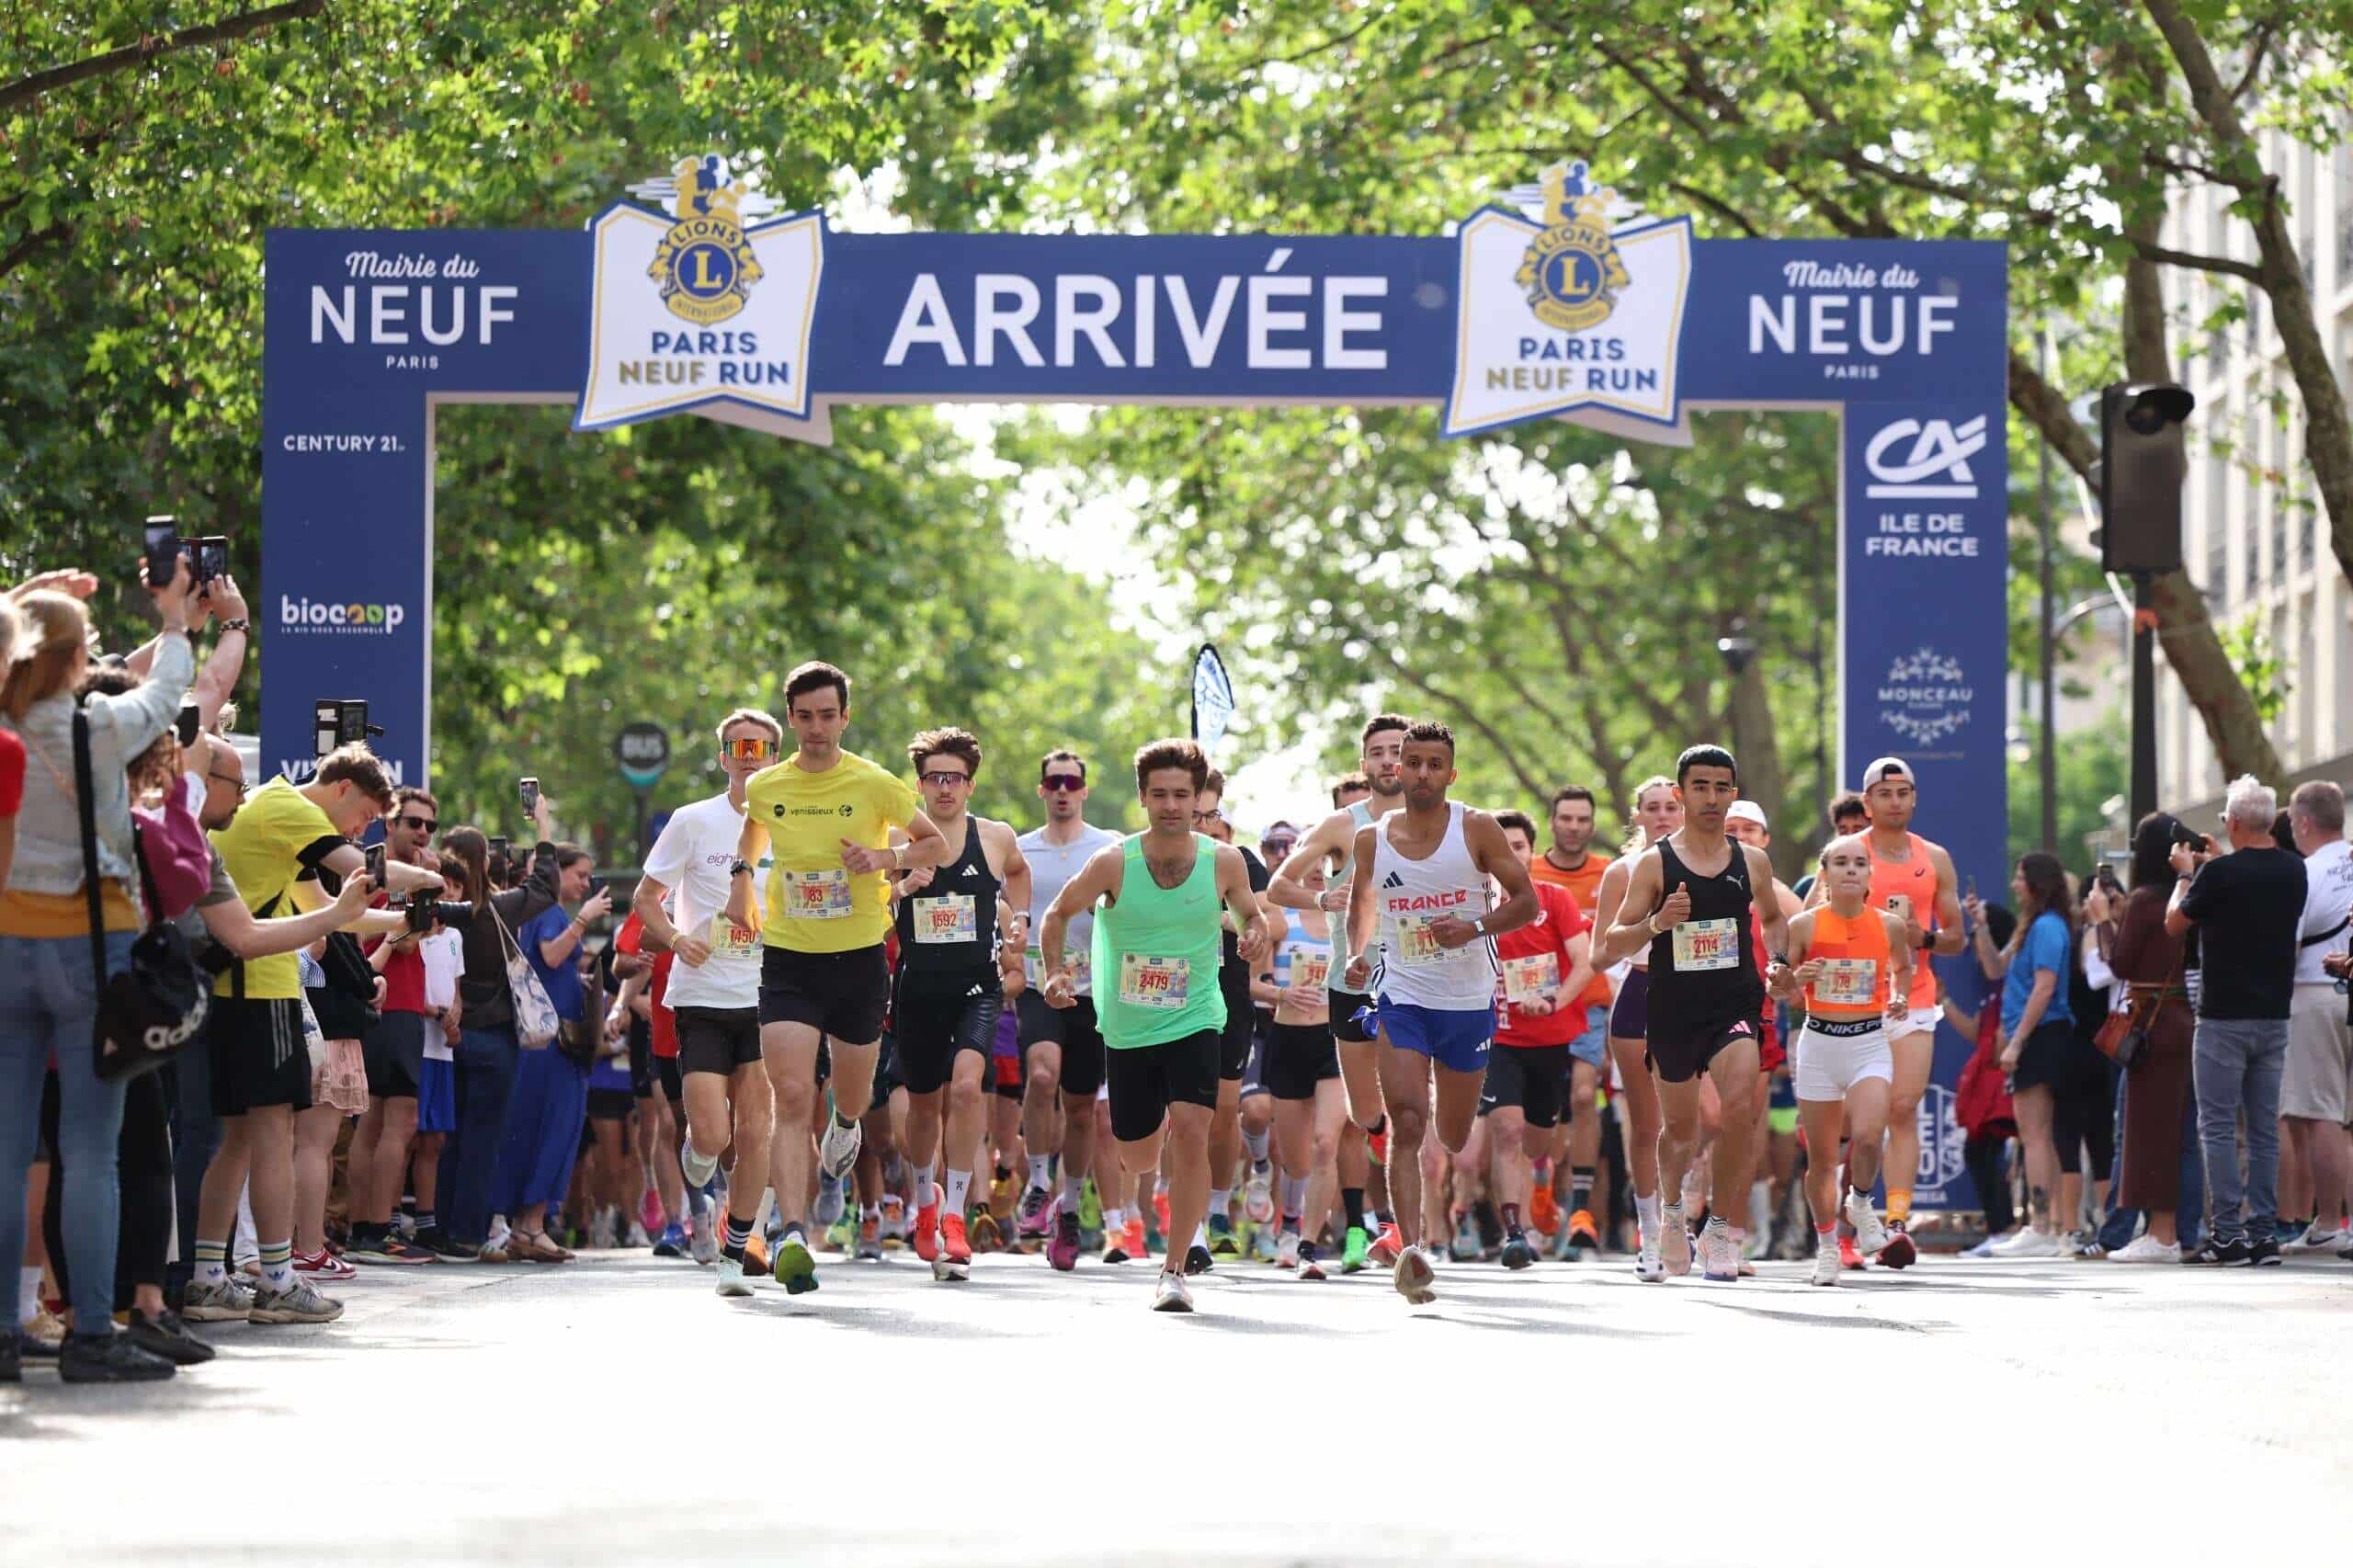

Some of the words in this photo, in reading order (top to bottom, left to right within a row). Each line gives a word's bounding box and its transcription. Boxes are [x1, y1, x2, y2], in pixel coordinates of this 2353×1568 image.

[674, 221, 740, 244] LIONS
[1542, 227, 1608, 250] LIONS
[345, 251, 437, 278] Mairie
[443, 255, 479, 278] du
[1782, 260, 1877, 289] Mairie
[1881, 264, 1919, 288] du
[311, 285, 518, 346] NEUF
[882, 247, 1389, 369] ARRIVÉE
[1748, 294, 1959, 356] NEUF
[651, 331, 757, 355] PARIS
[1519, 337, 1625, 361] PARIS
[386, 355, 438, 369] PARIS
[620, 359, 707, 384] NEUF
[719, 361, 790, 385] RUN
[1823, 364, 1880, 380] PARIS
[1486, 367, 1573, 390] NEUF
[1587, 369, 1657, 392] RUN
[283, 435, 376, 451] CENTURY
[1880, 513, 1921, 532] ILE
[1927, 513, 1964, 533] DE
[1866, 537, 1979, 557] FRANCE
[281, 594, 404, 634] biocoop
[1878, 688, 1973, 702] MONCEAU
[707, 853, 736, 867] eigh
[809, 889, 824, 903] 83
[1388, 889, 1468, 912] FRANCE
[1139, 973, 1168, 991] 2479
[1824, 1022, 1865, 1034] NIKE
